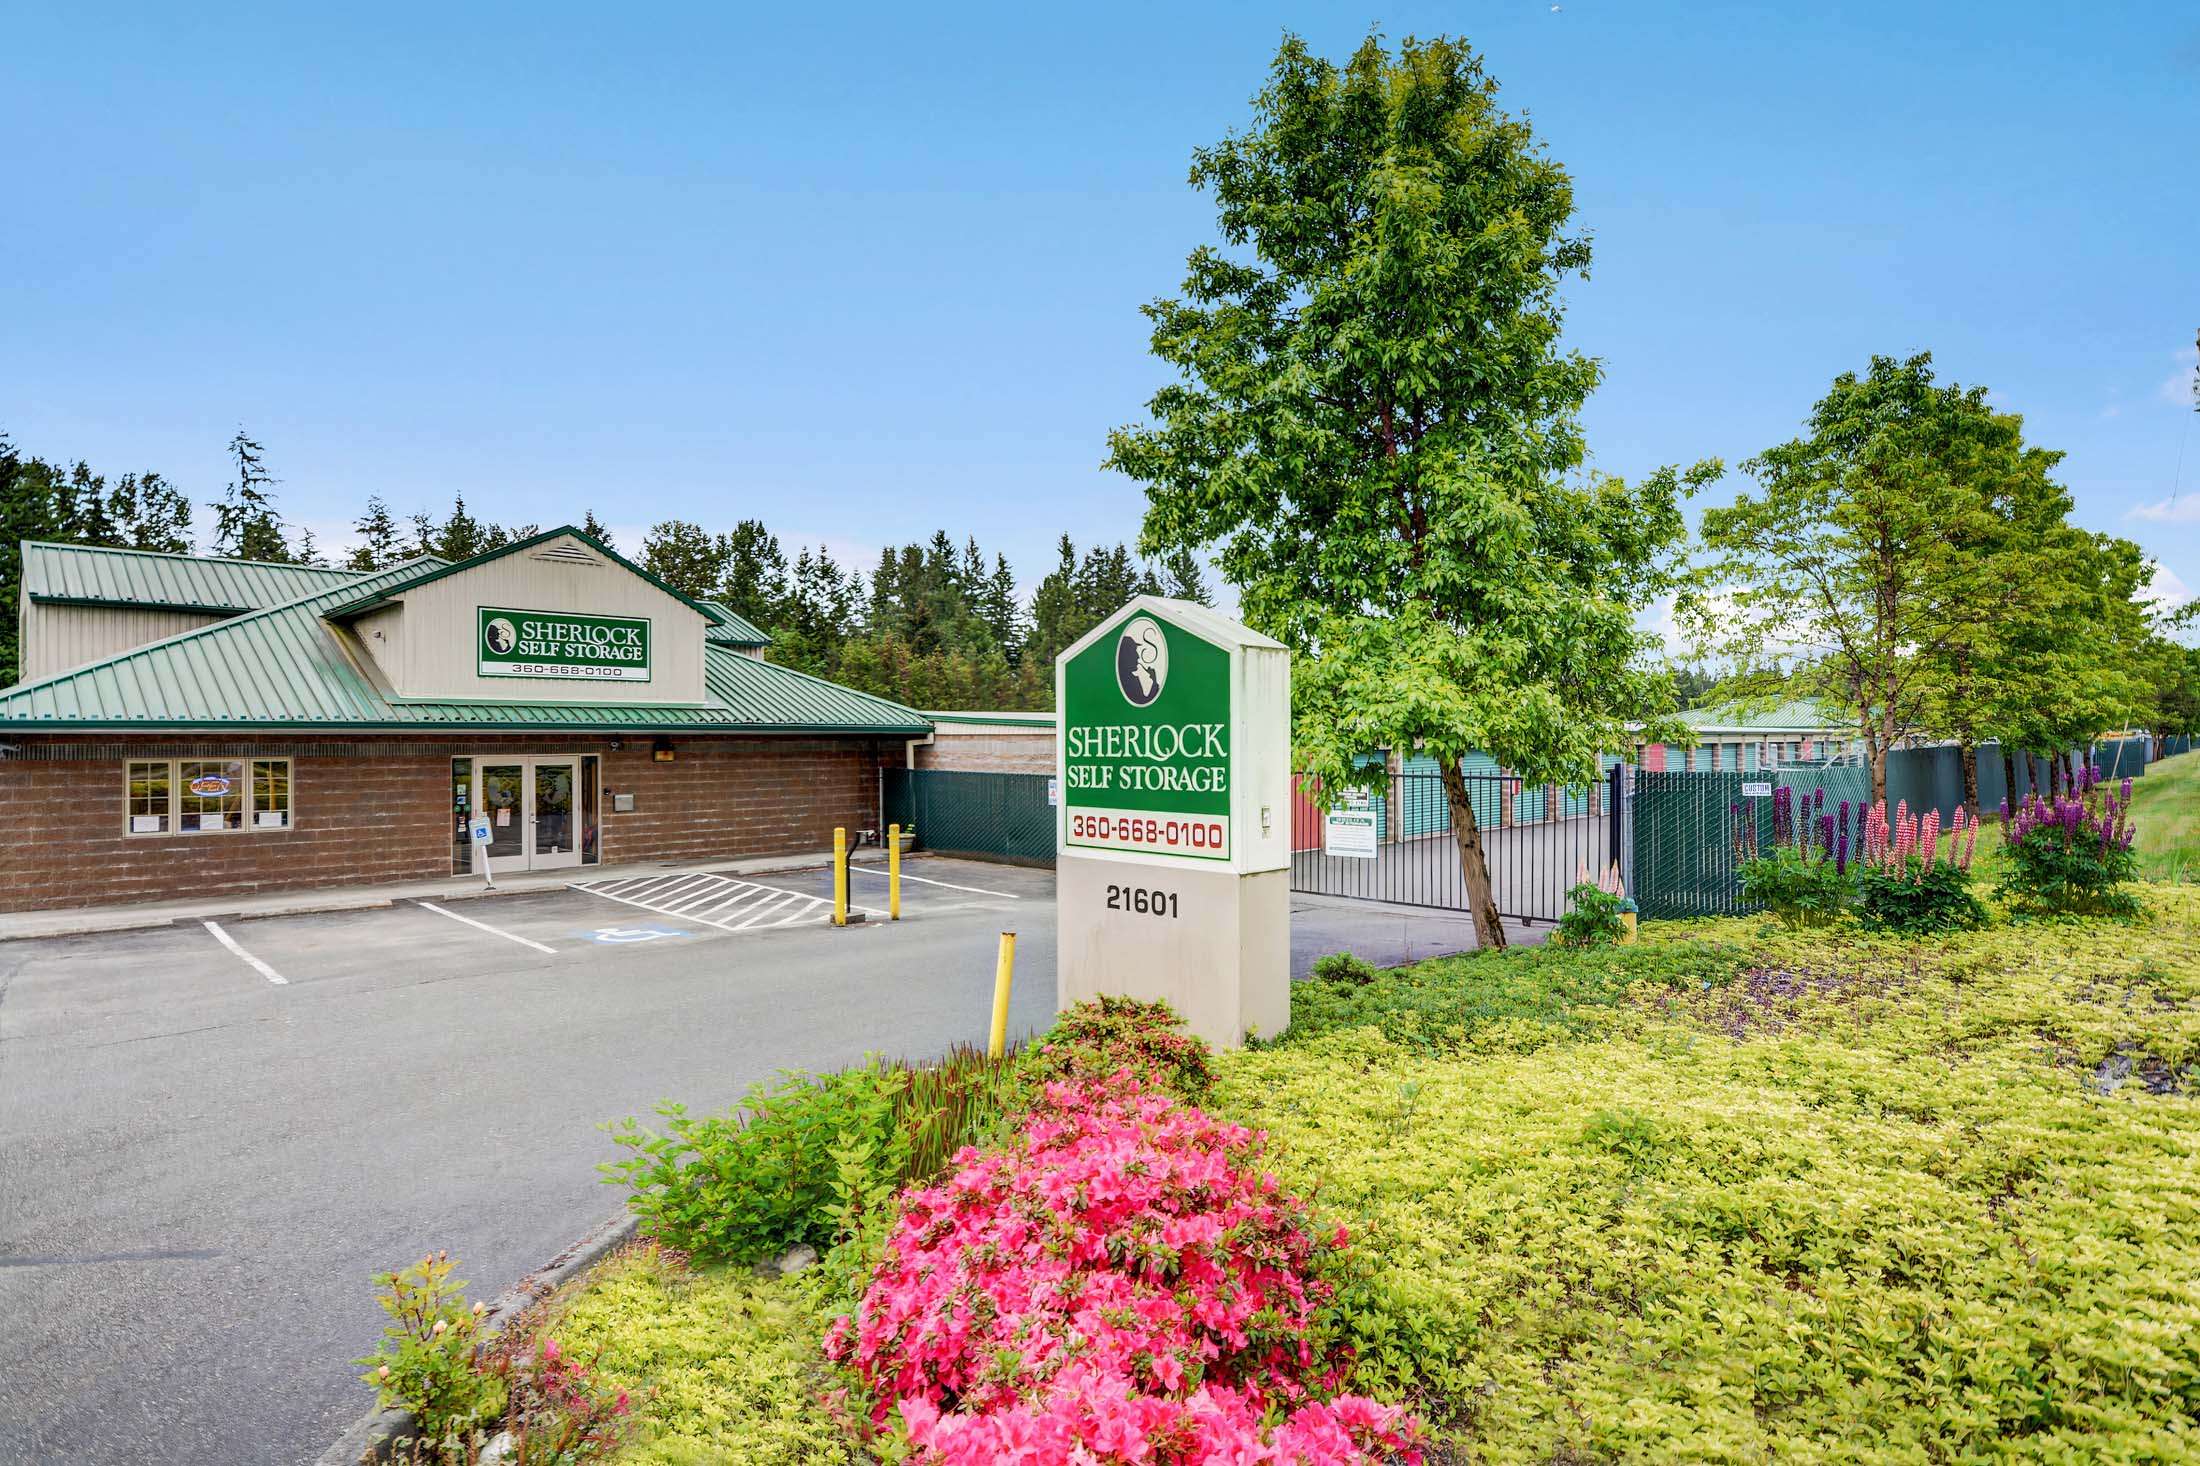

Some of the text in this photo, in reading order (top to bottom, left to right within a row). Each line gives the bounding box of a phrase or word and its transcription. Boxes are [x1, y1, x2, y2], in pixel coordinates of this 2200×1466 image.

[522, 621, 642, 645] SHERLOCK
[518, 640, 643, 661] SELF STORAGE
[512, 664, 622, 676] 360-668-0100
[1068, 724, 1227, 761] SHERLOCK
[191, 780, 228, 792] OPEN
[1068, 765, 1227, 792] SELF STORAGE
[1073, 815, 1223, 849] 360-668-0100
[1106, 885, 1178, 919] 21601
